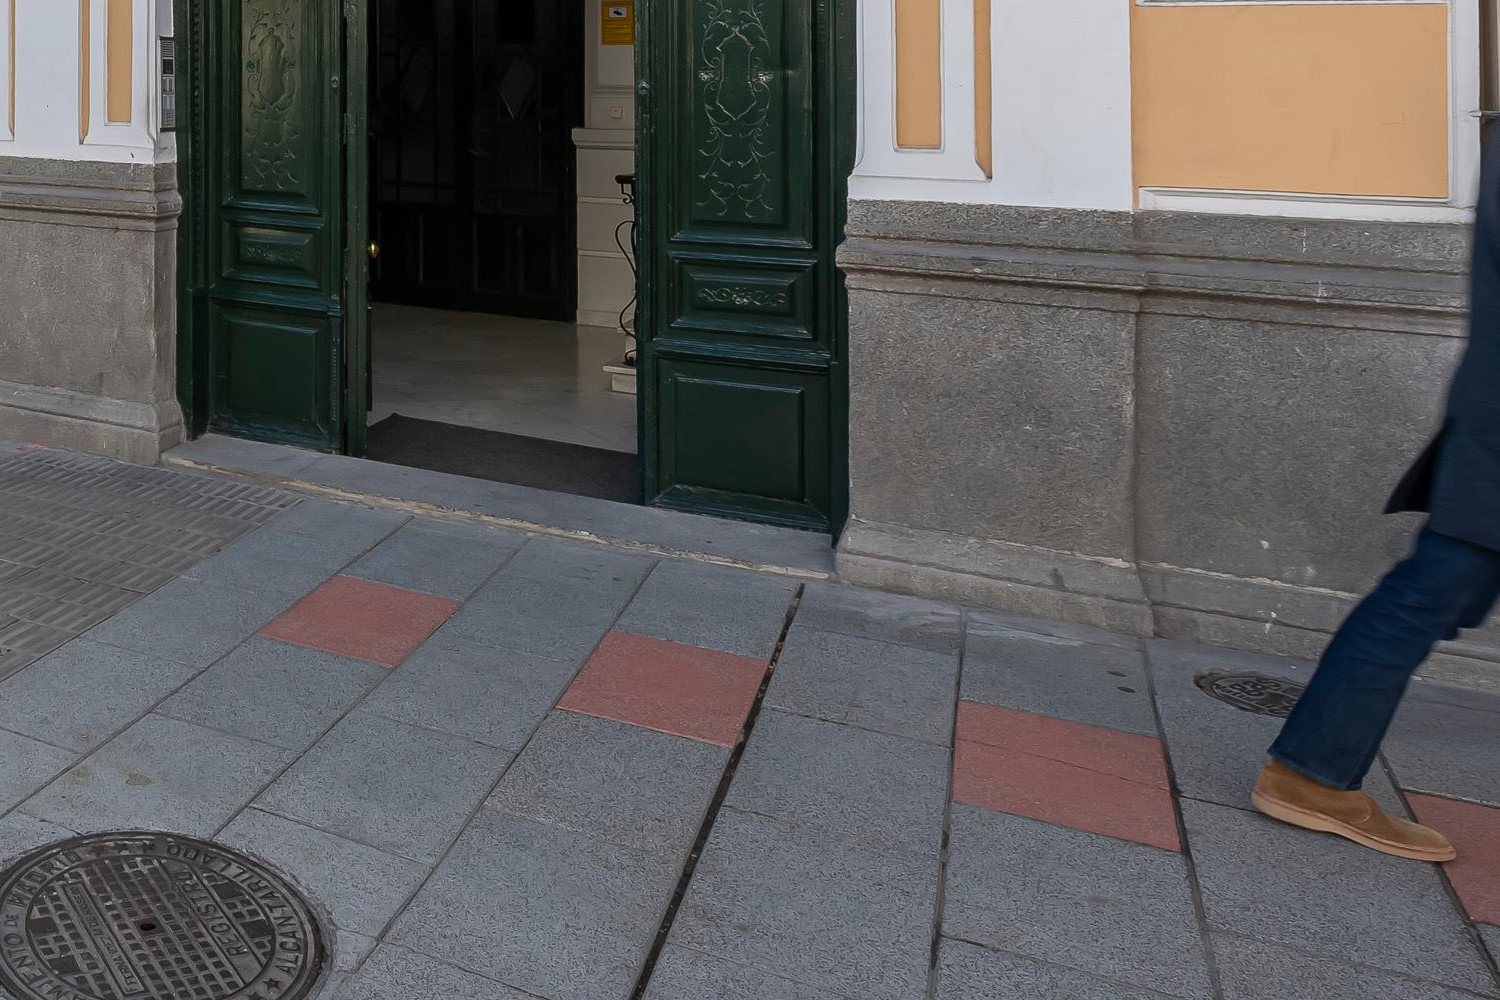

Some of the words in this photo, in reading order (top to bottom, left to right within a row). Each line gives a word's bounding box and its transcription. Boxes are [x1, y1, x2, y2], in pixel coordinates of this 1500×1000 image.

[3, 848, 80, 908] MADRID
[166, 843, 301, 976] ALCANTARILLADO
[175, 870, 249, 957] REGISTRO
[3, 913, 21, 928] DE
